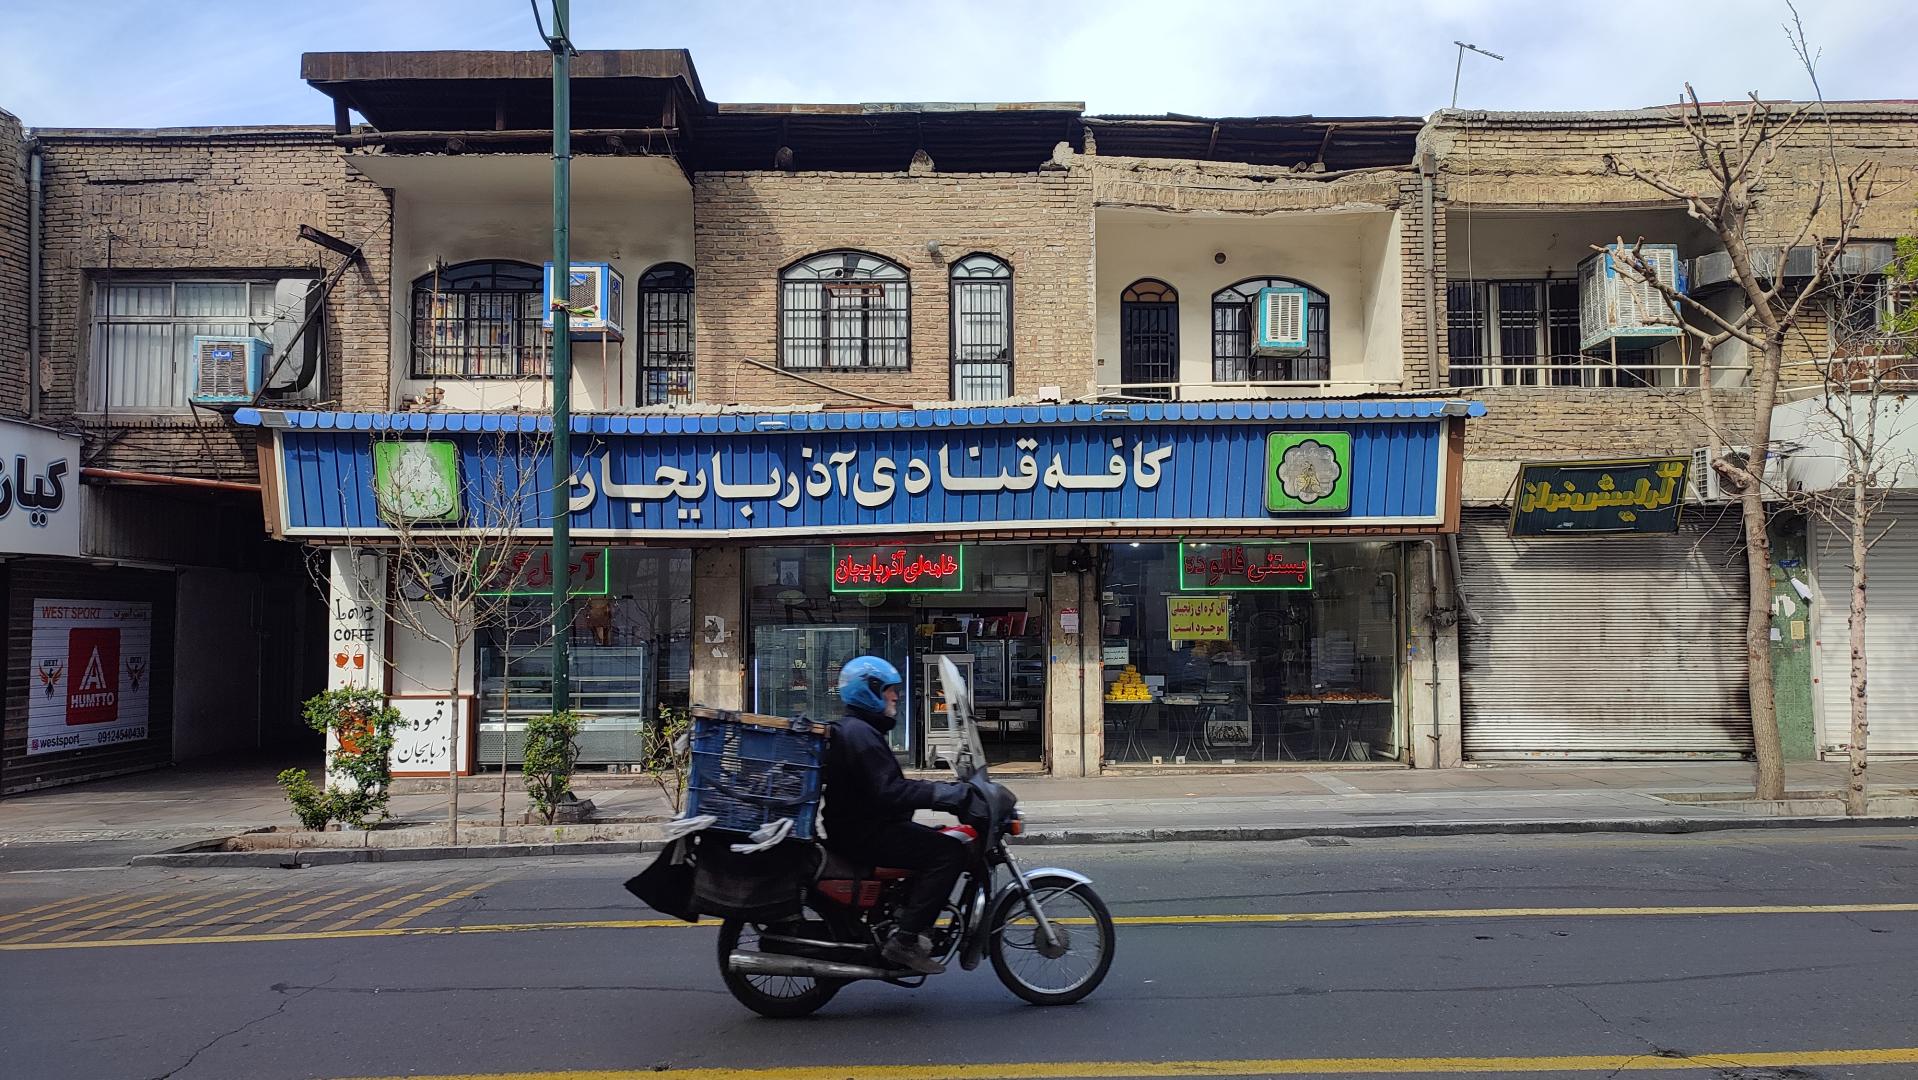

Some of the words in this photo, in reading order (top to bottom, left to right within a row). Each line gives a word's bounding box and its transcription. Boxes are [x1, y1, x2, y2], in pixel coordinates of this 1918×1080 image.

[852, 437, 1039, 507] قنادی
[1043, 436, 1173, 489] کافه
[569, 447, 857, 520] آذربایجان
[836, 549, 907, 583] آذربایجان
[1247, 552, 1308, 583] بستنی
[42, 606, 69, 619] WEST
[71, 606, 102, 620] SPORT
[1174, 622, 1194, 632] است
[334, 627, 375, 641] COFFE
[1196, 624, 1224, 636] موجود
[70, 692, 115, 709] HUMTTO
[413, 701, 445, 732] قهوه
[398, 736, 452, 764] ذربایجان
